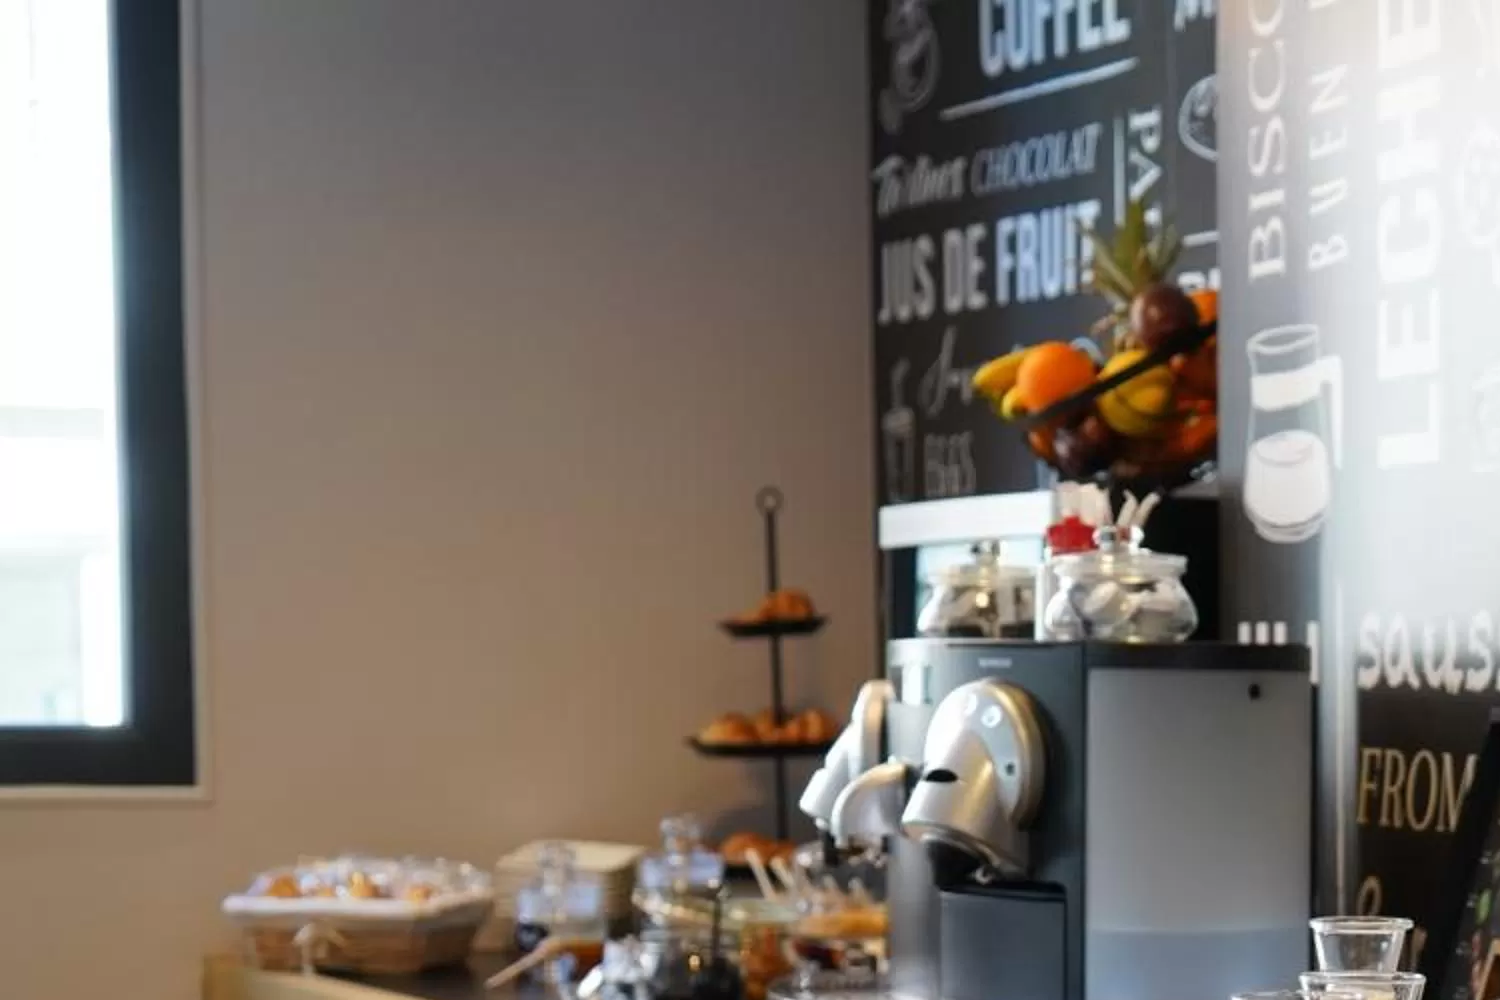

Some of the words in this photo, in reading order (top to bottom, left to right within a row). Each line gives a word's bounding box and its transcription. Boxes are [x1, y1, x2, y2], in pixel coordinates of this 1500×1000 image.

[1308, 64, 1348, 271] BUEN
[1376, 0, 1441, 470] LECHE
[878, 234, 936, 326] JUS
[943, 222, 989, 314] DE
